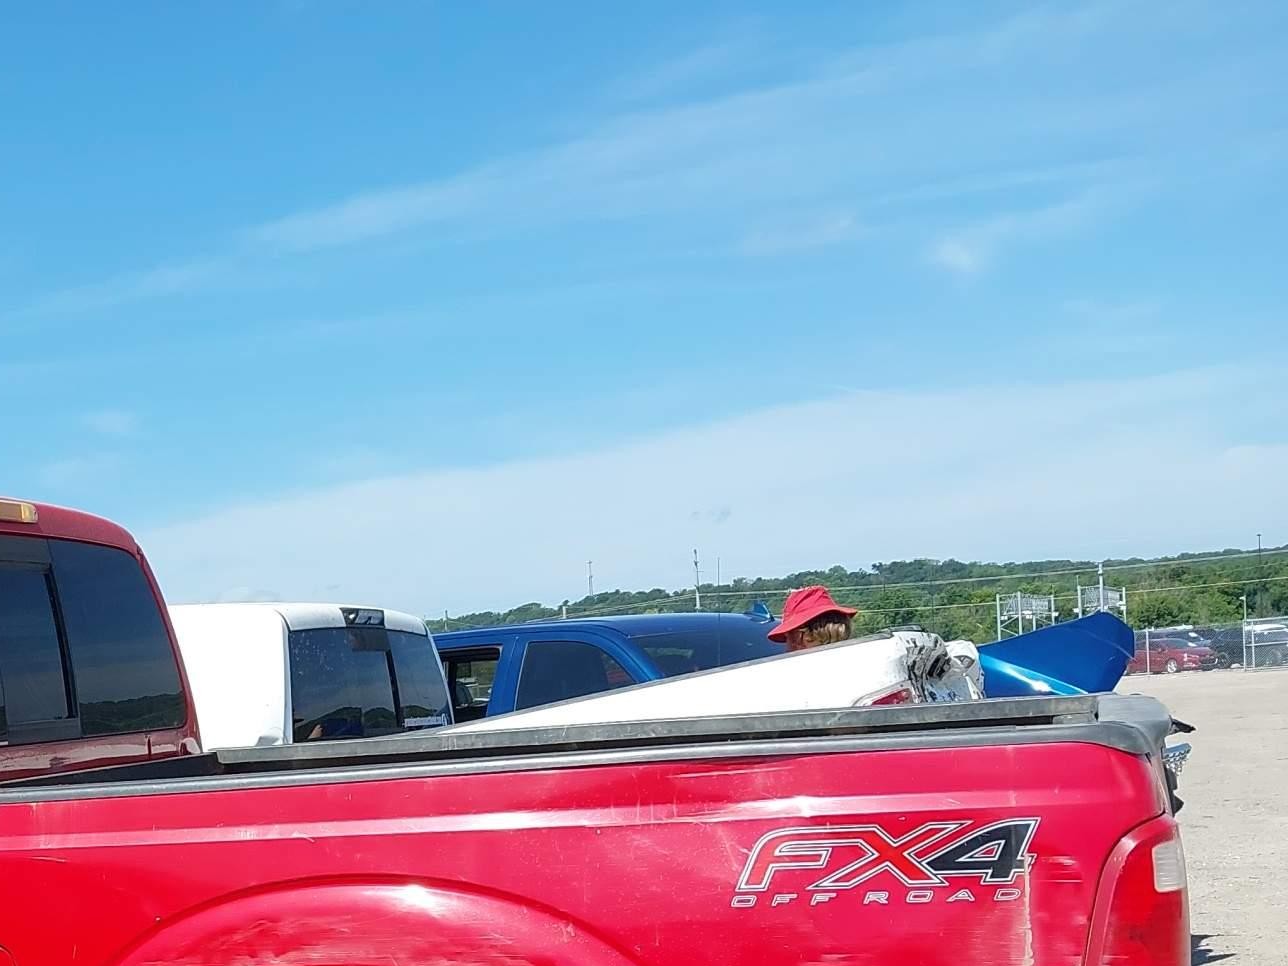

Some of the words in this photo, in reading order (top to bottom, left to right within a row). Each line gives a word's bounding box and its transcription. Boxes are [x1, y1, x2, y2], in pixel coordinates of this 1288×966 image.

[736, 817, 1041, 892] FX4
[731, 892, 837, 908] OFF
[863, 889, 1022, 905] ROAD
